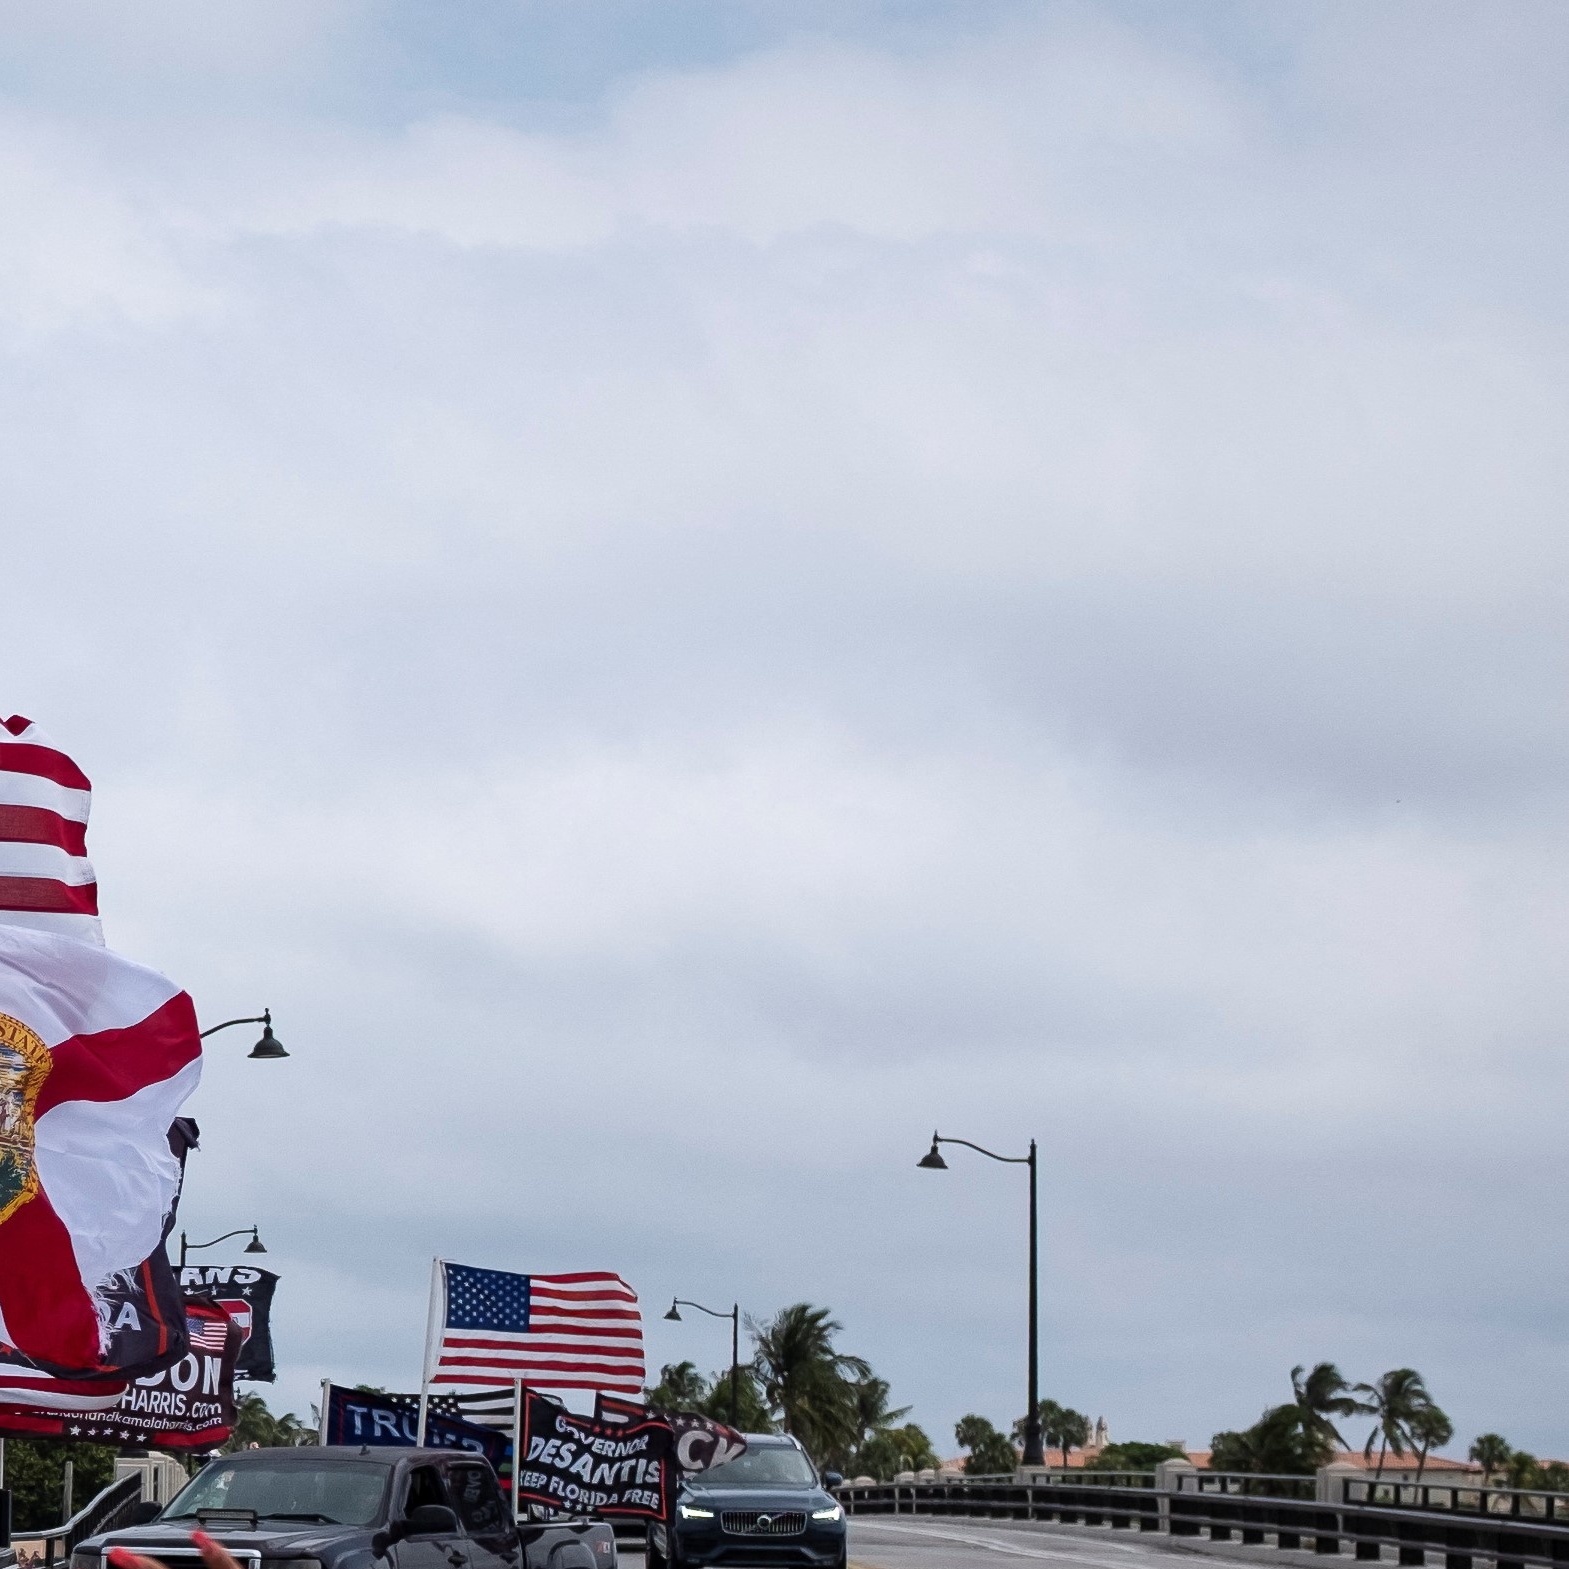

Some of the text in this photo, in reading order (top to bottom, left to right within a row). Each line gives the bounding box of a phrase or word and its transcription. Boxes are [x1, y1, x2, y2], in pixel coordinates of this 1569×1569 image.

[554, 1415, 650, 1459] GOVERNOR
[526, 1433, 662, 1486] DESANTIS
[548, 1474, 619, 1507] FLORIDA
[621, 1488, 660, 1511] FREE
